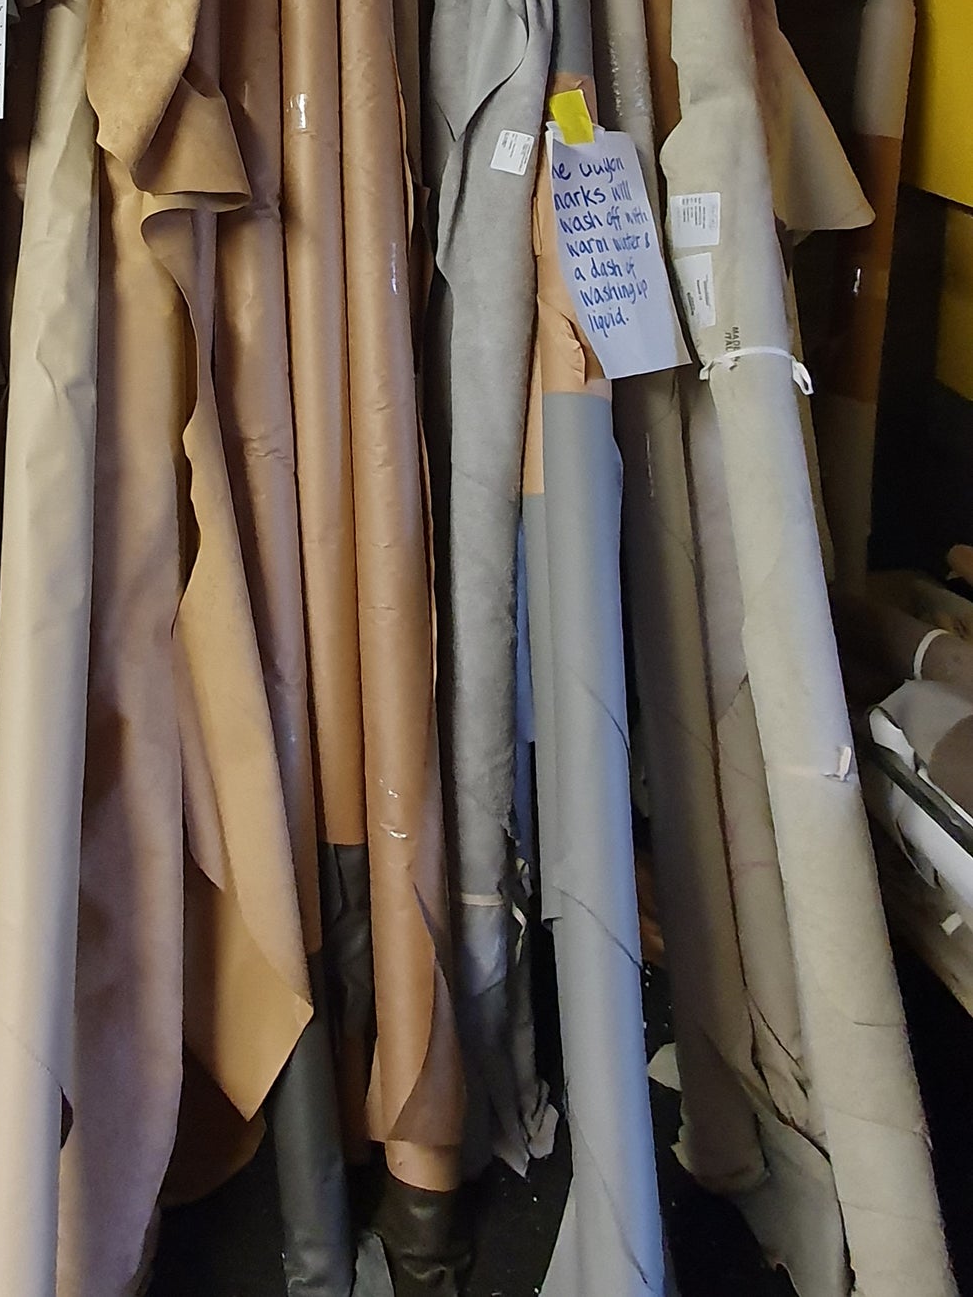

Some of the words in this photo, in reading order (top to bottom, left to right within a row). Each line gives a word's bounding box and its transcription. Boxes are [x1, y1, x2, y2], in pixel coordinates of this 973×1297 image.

[559, 211, 603, 234] wash
[606, 205, 622, 231] off
[566, 237, 610, 257] warm
[574, 266, 587, 281] a
[590, 256, 623, 279] dash
[724, 332, 732, 352] ITAL
